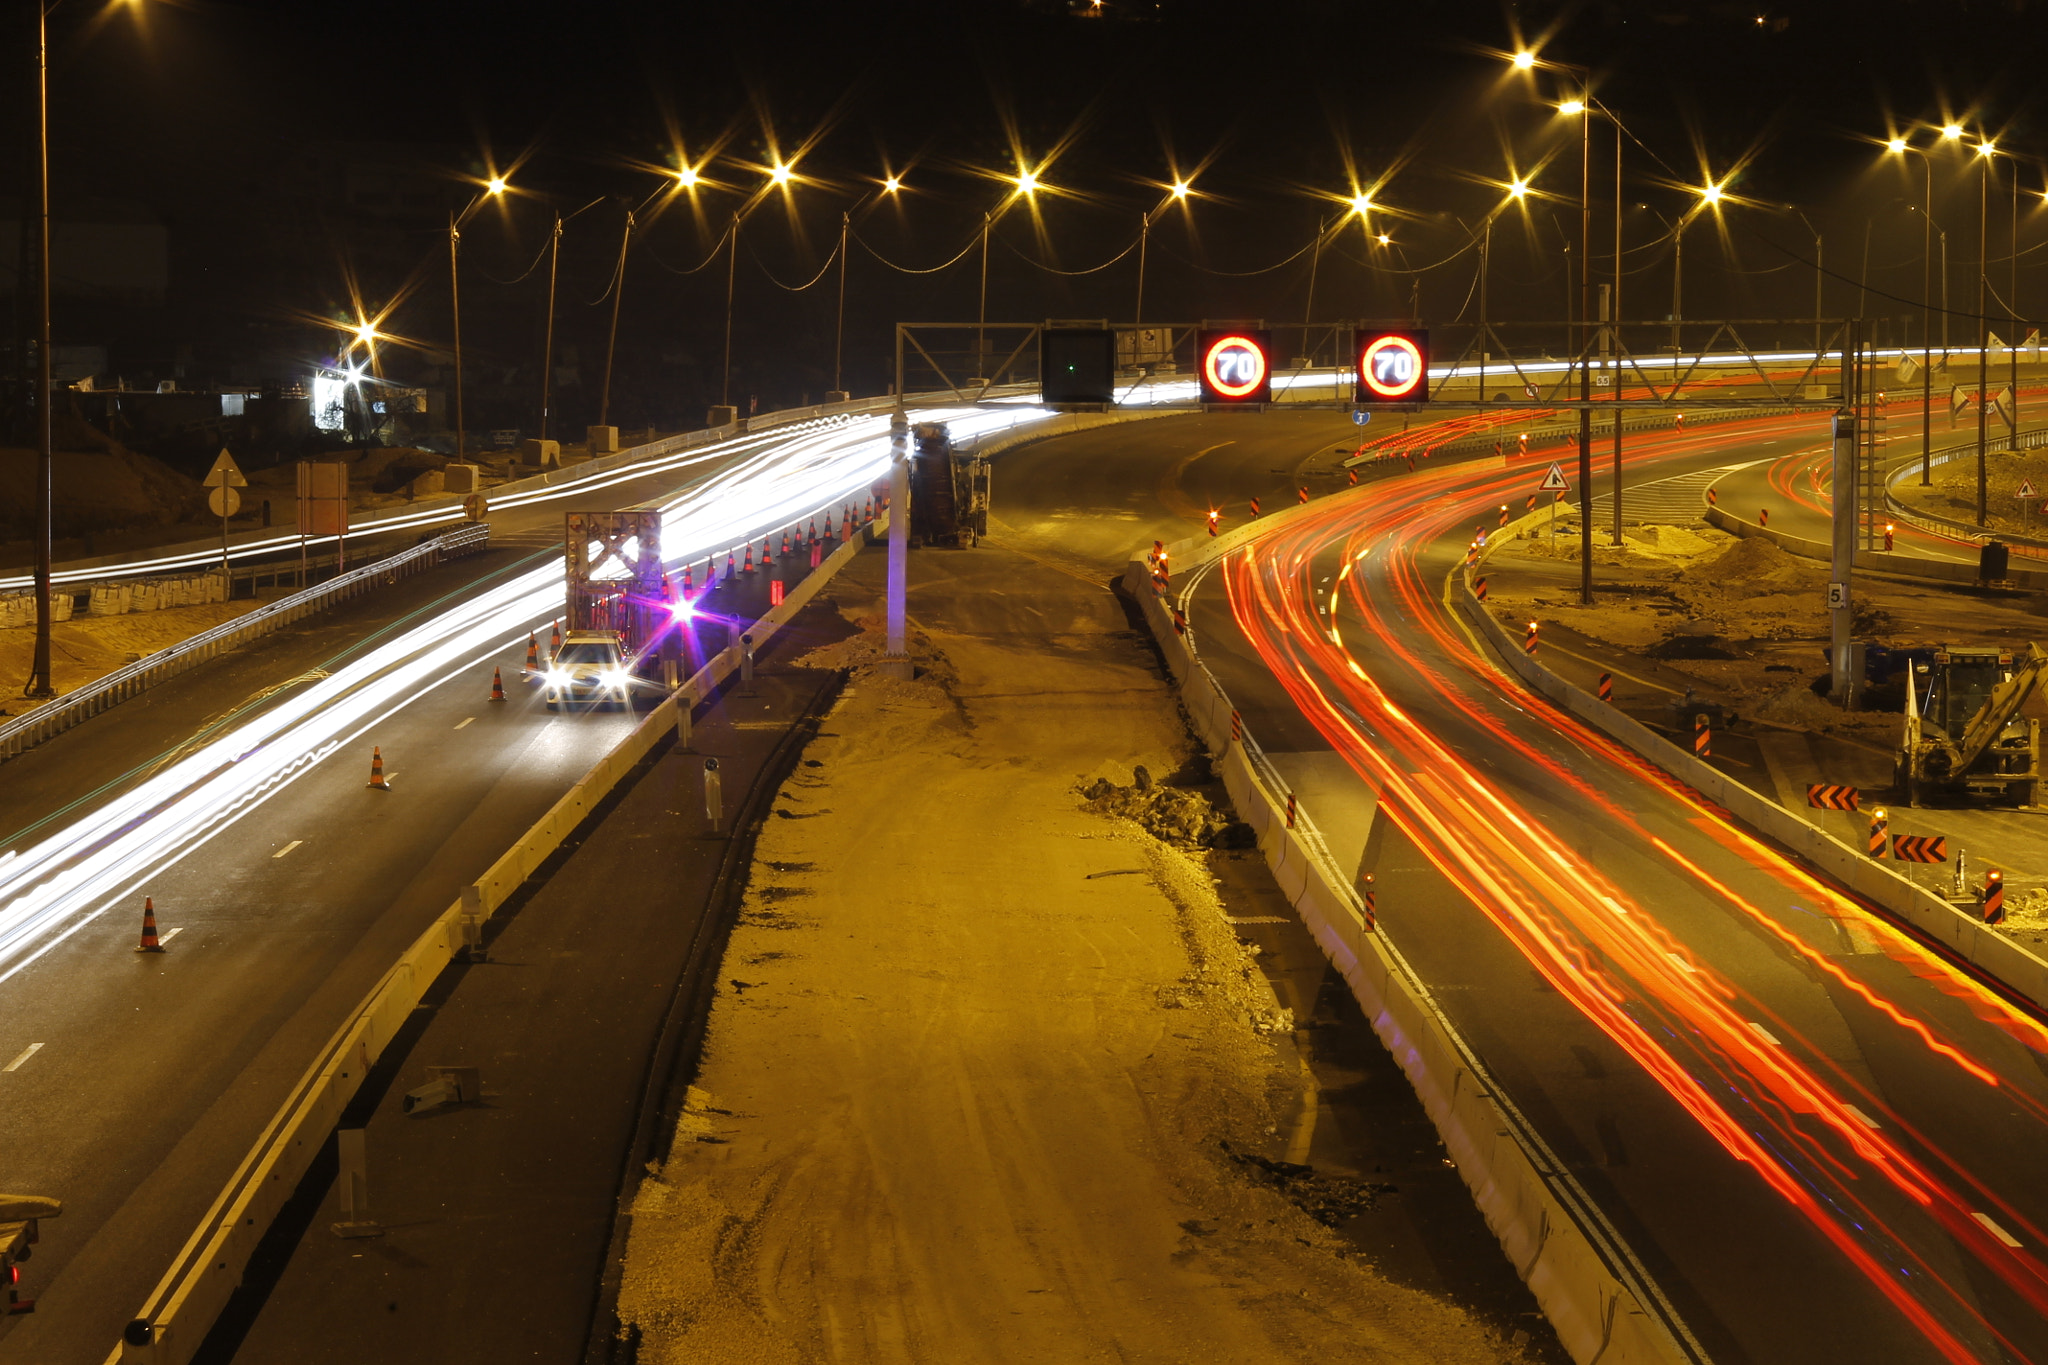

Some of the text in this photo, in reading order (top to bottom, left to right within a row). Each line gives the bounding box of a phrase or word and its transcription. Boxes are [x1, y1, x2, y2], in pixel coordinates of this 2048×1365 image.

[1217, 352, 1255, 381] 70
[1374, 352, 1412, 380] 70
[1831, 589, 1840, 603] 5
